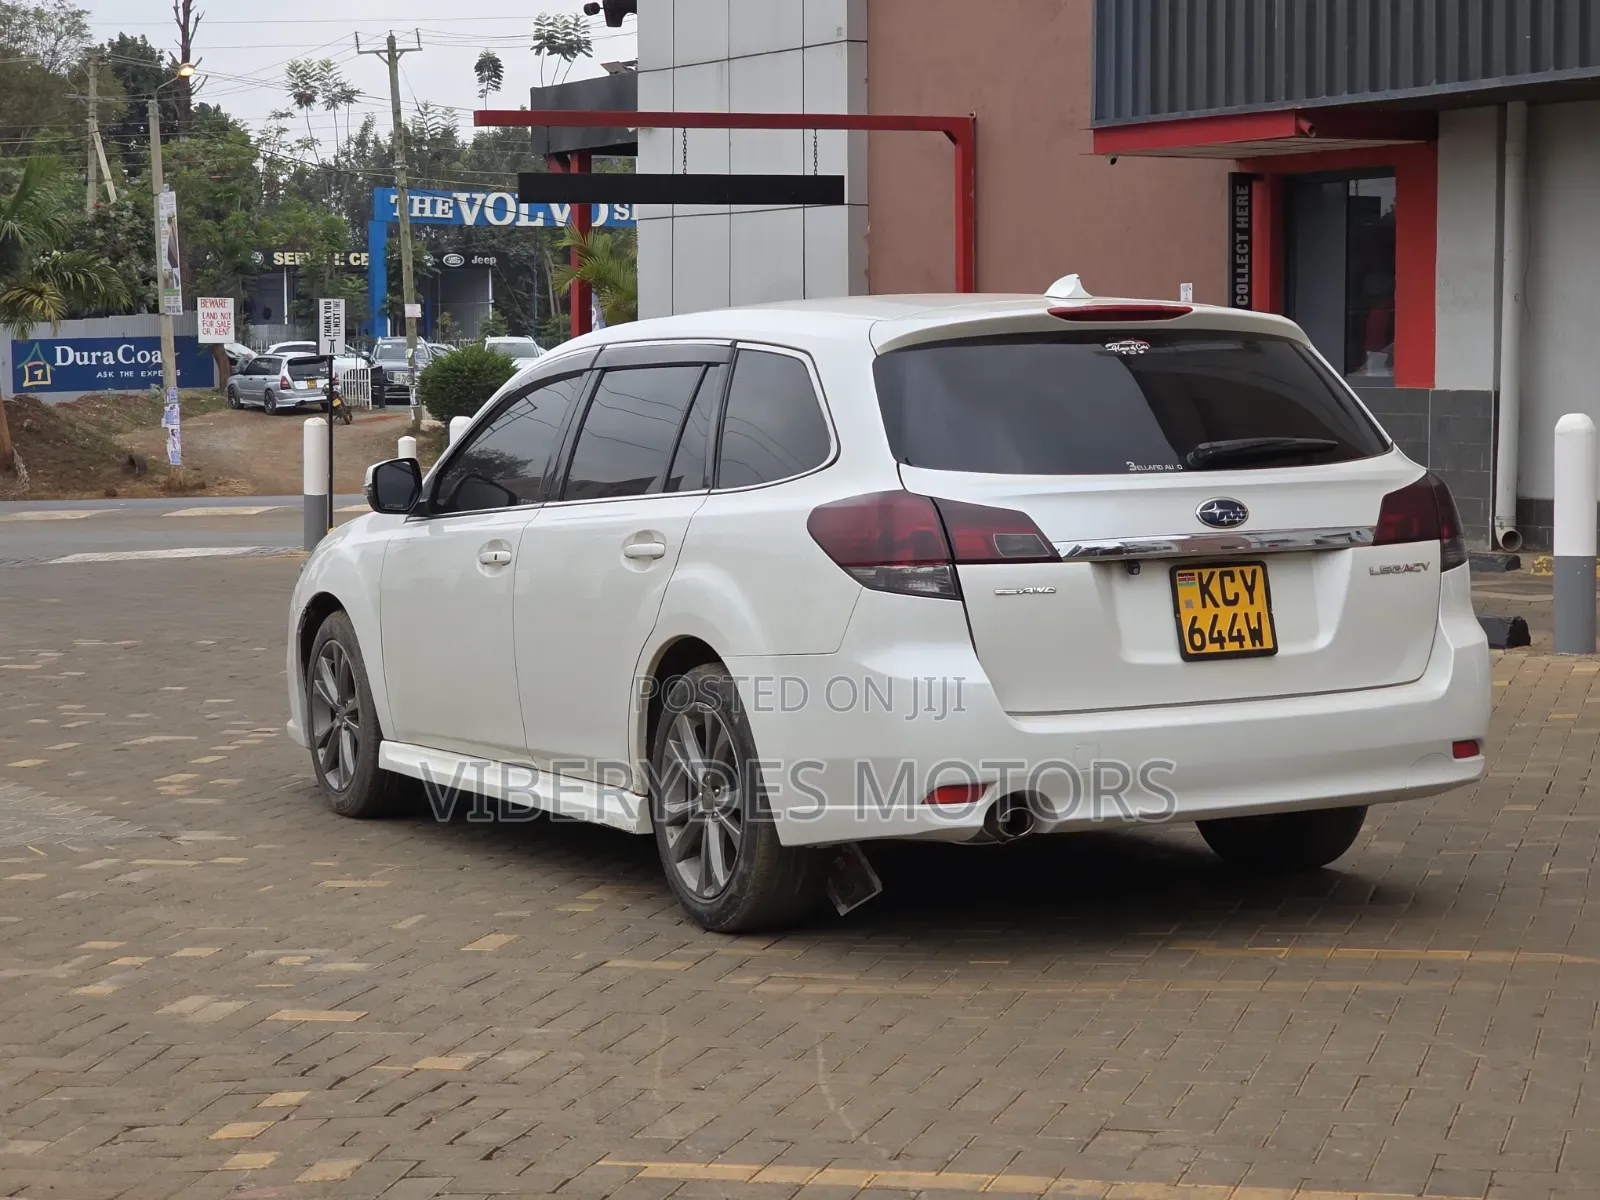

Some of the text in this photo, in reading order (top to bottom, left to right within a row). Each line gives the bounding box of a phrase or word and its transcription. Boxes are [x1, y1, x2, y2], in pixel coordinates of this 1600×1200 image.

[390, 194, 453, 219] THE
[1236, 185, 1249, 306] COLLECT HERE
[471, 255, 497, 266] Jeep
[200, 298, 229, 309] BEWARE
[202, 312, 232, 320] LAND NOT
[323, 300, 332, 337] THANK YOU
[332, 313, 341, 328] NEXT
[202, 320, 232, 329] FOR SALE
[202, 328, 230, 336] OR RENT
[54, 344, 180, 366] DuraCoa
[96, 369, 181, 379] ASK THE EXPES
[1369, 561, 1431, 575] LEGACY
[1197, 568, 1257, 609] KCY
[1187, 611, 1264, 652] 644W
